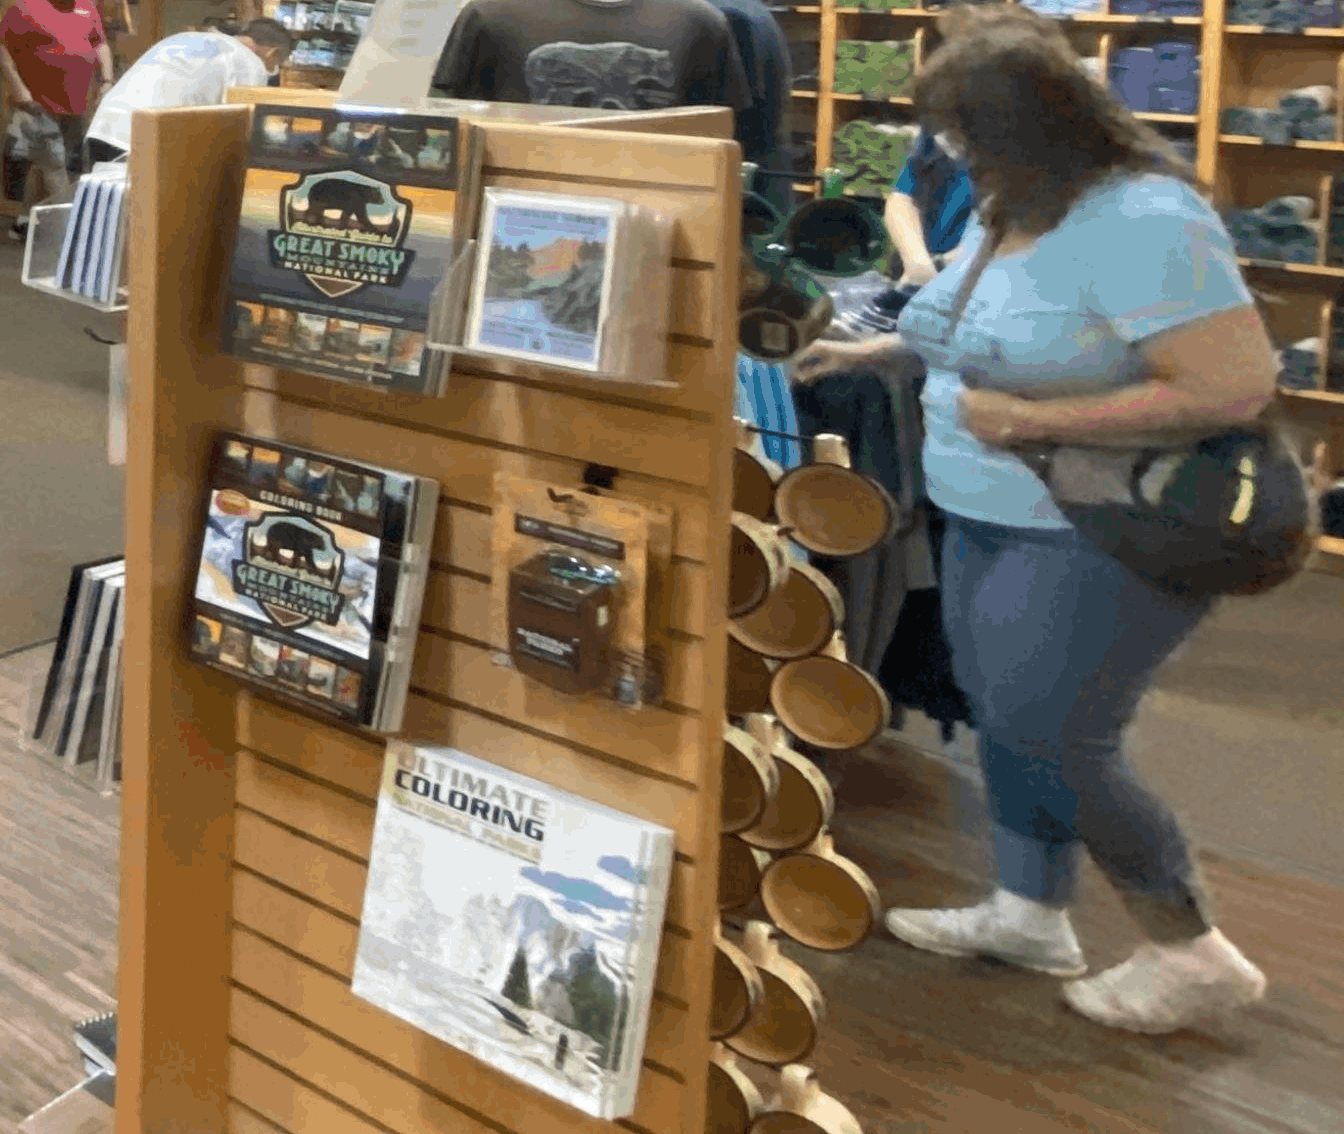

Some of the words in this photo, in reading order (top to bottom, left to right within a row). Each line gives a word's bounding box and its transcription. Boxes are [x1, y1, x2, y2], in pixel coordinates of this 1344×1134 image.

[273, 233, 336, 258] GREAT
[338, 242, 405, 275] SMOKY
[284, 261, 350, 279] NATIONAL
[353, 270, 387, 284] PARK
[259, 490, 313, 513] COLORING
[315, 505, 342, 521] BOOK
[236, 564, 287, 587] GREAT
[289, 580, 340, 614] SMOKY
[395, 769, 544, 842] COLORING
[397, 751, 549, 819] ULTIMATE
